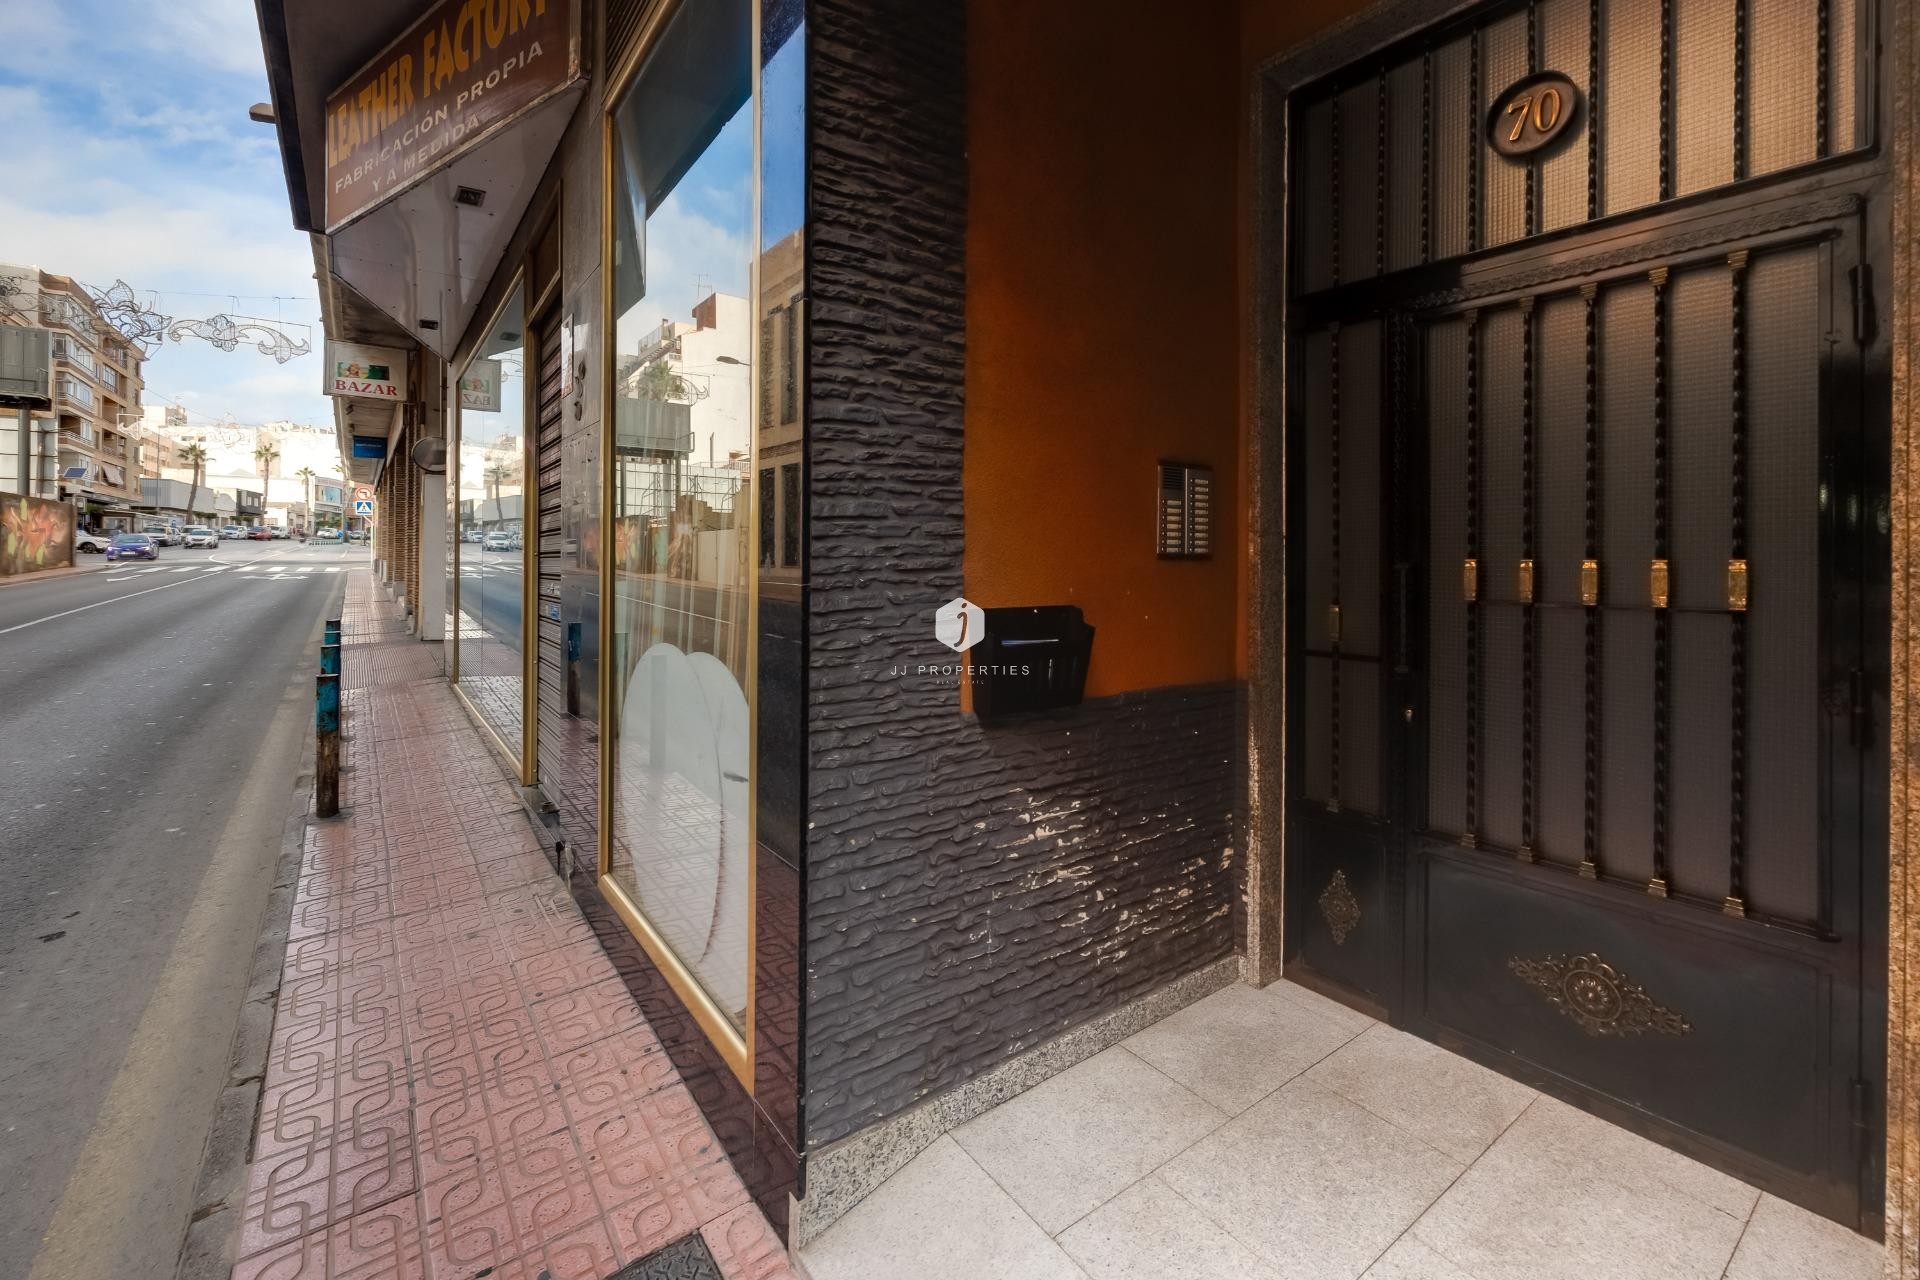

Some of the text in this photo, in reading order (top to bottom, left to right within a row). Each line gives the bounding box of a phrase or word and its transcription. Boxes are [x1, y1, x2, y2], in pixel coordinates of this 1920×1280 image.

[328, 54, 414, 169] LEATHER
[335, 41, 543, 194] FABRICACIÓN PROPIA
[1507, 89, 1561, 141] 70
[372, 113, 480, 192] Y A MEDIDA
[335, 379, 398, 396] BAZAR
